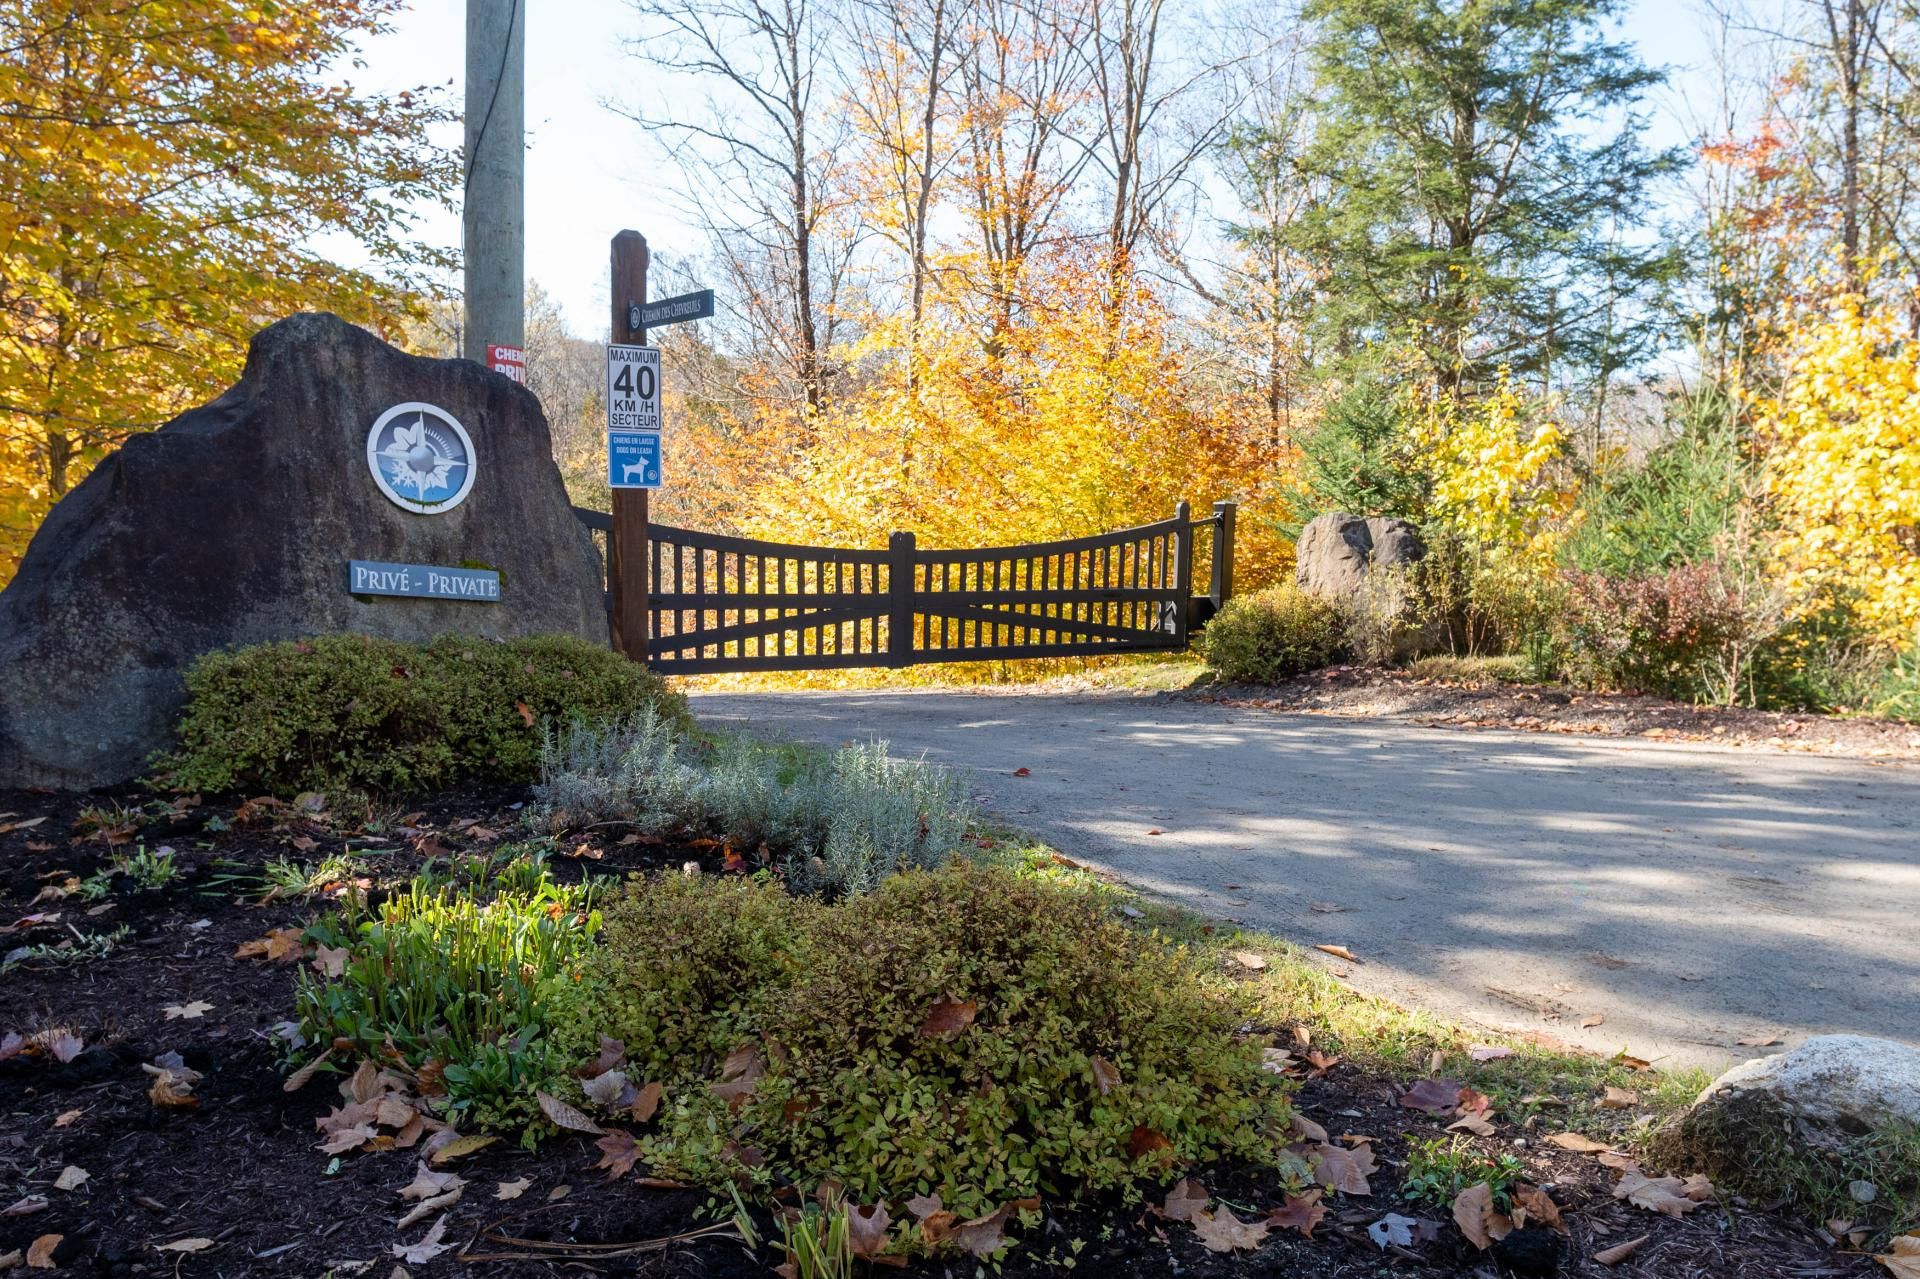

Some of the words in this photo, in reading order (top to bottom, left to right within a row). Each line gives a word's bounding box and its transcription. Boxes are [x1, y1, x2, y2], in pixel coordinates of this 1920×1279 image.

[610, 349, 658, 364] MAXIMUM
[613, 364, 655, 400] 40
[614, 400, 636, 412] KM
[640, 401, 655, 413] /H
[611, 413, 658, 427] SECTEUR
[637, 447, 653, 455] LEASH
[355, 567, 409, 591] PRIVÉ
[428, 572, 497, 597] PRIVATE
